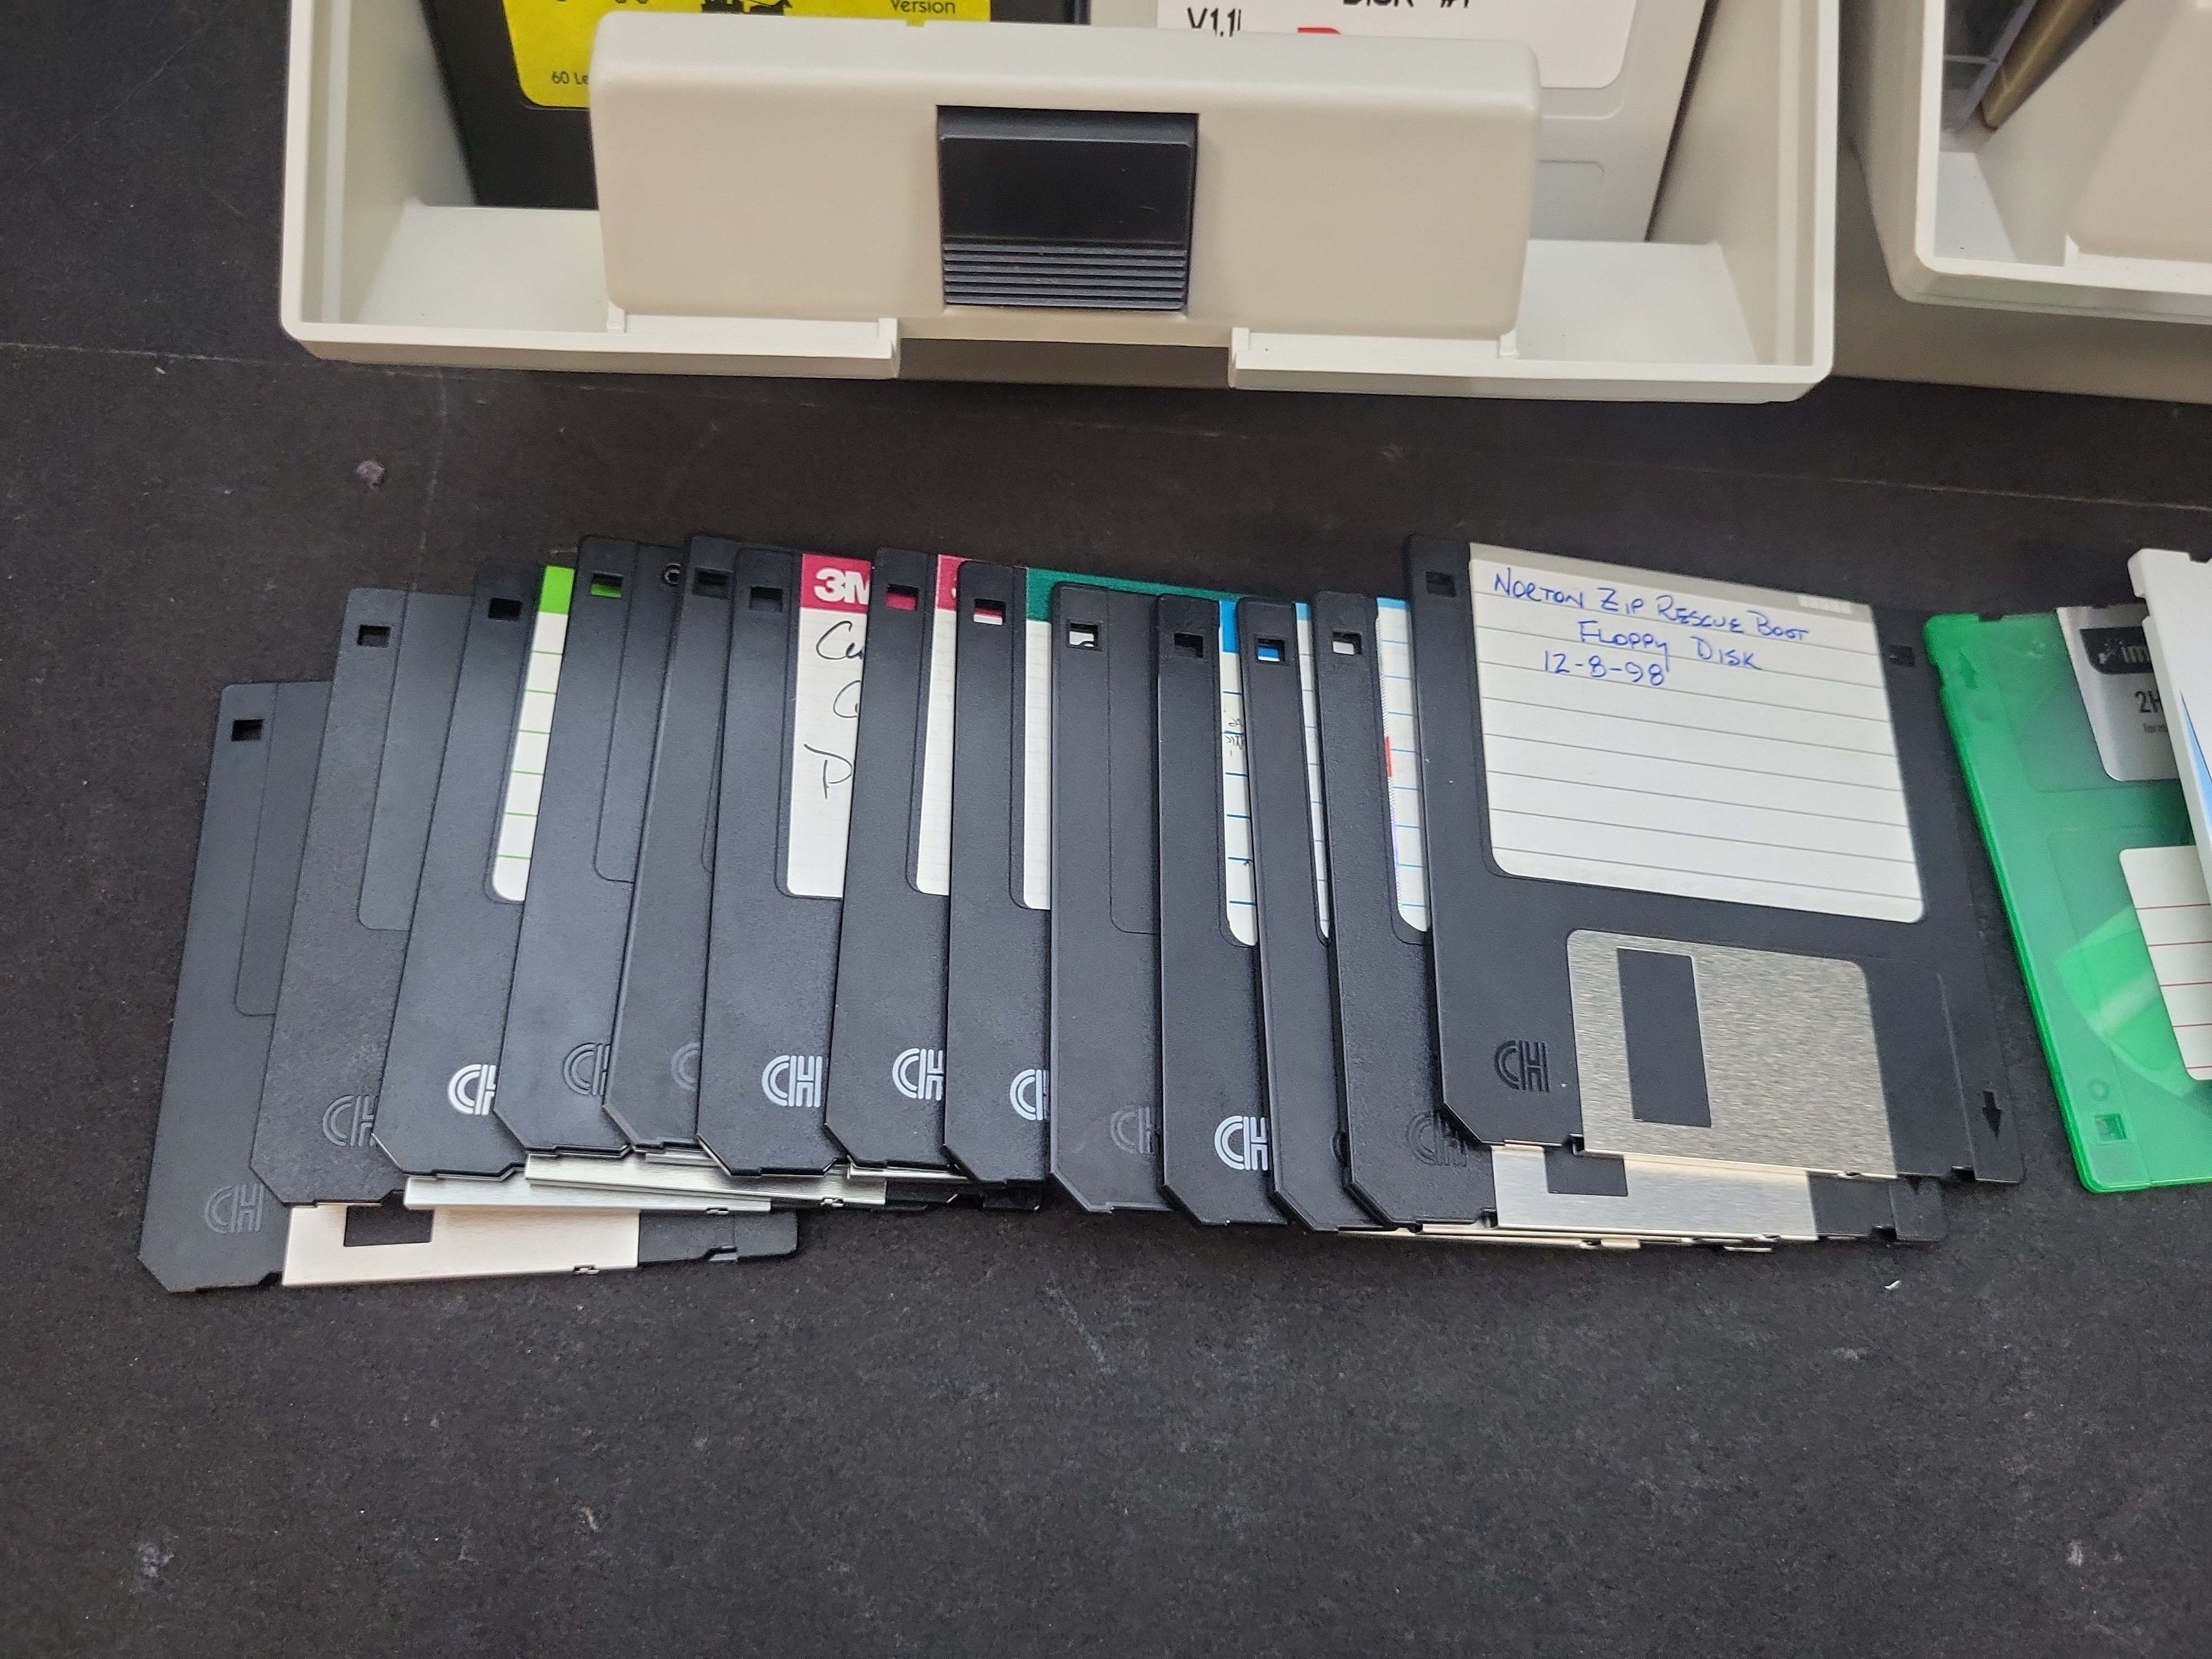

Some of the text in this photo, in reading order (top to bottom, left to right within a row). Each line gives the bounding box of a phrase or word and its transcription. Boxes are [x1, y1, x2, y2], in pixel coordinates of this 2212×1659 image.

[889, 0, 956, 14] Version
[551, 70, 570, 84] 60
[814, 567, 870, 604] 3M
[1494, 567, 1583, 608] NORTON
[1656, 594, 1744, 634] RESCUE
[1747, 610, 1809, 641] BOOT
[1544, 650, 1665, 686] 12-8-98
[1689, 637, 1762, 671] DISK
